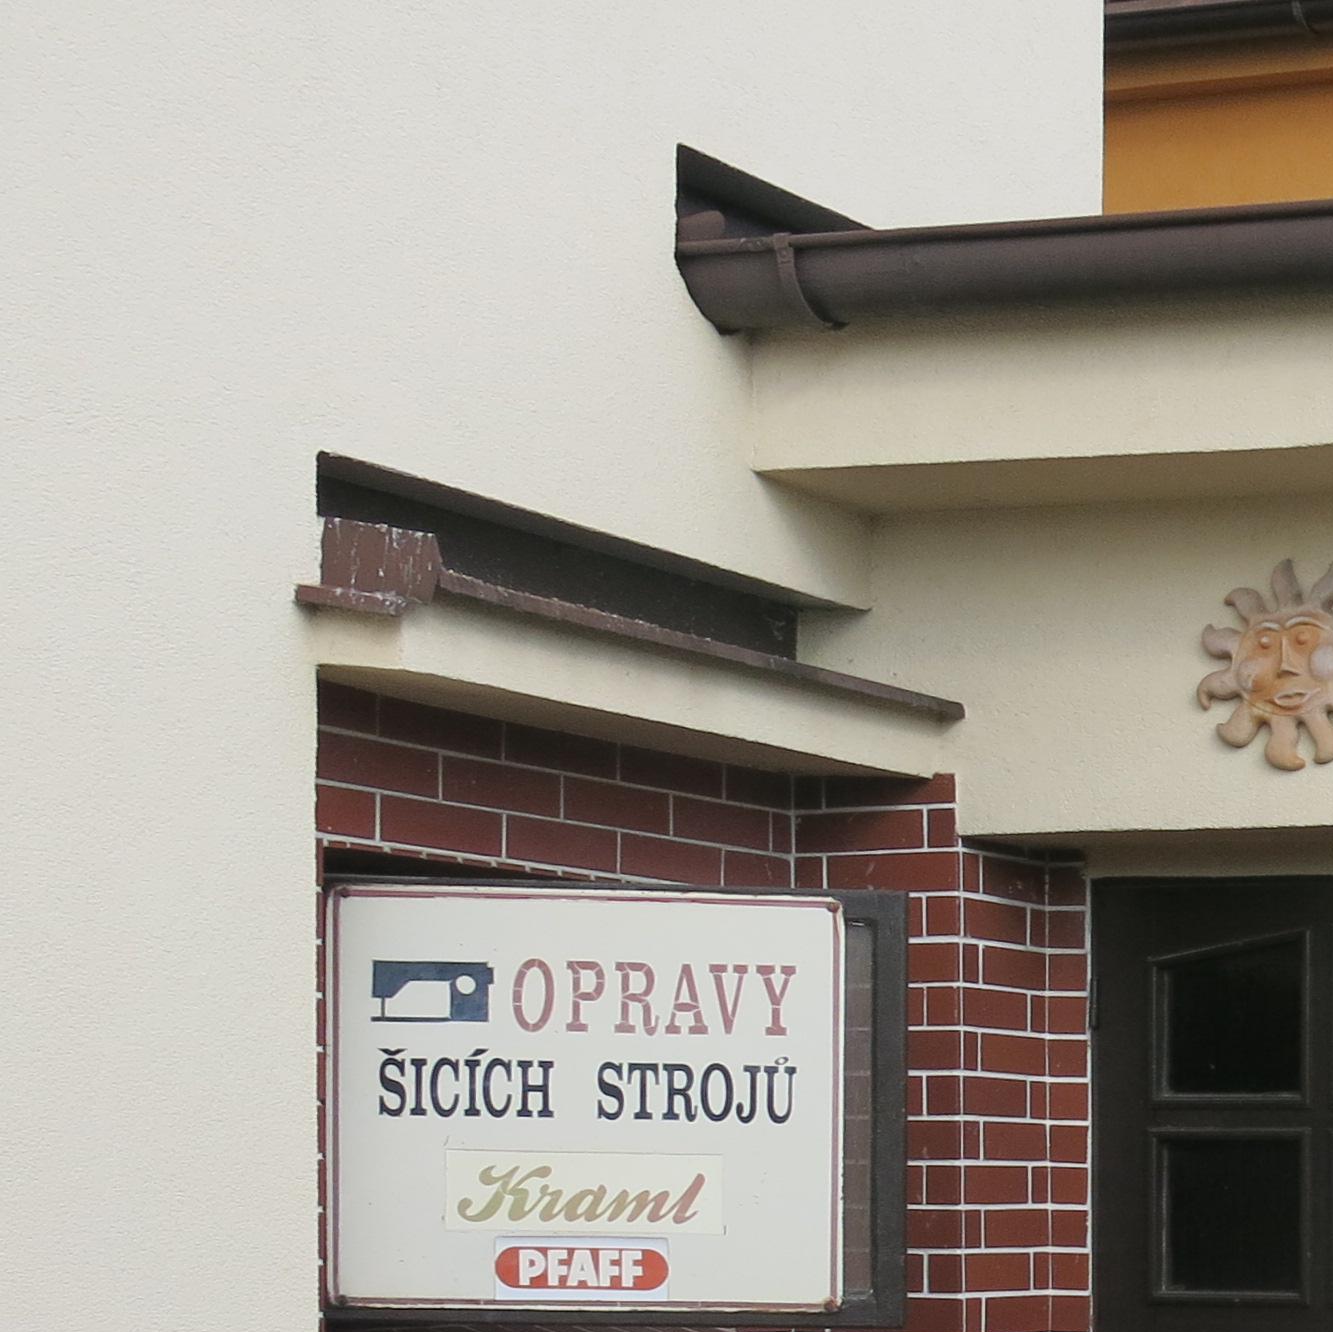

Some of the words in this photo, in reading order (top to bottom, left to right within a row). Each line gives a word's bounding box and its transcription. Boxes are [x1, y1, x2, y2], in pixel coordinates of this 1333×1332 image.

[512, 958, 797, 1036] OPRAVY
[378, 1048, 554, 1118] ŠICÍCH
[597, 1056, 797, 1124] STROJŮ
[457, 1164, 706, 1223] Kraml
[518, 1249, 645, 1287] PFAFF
